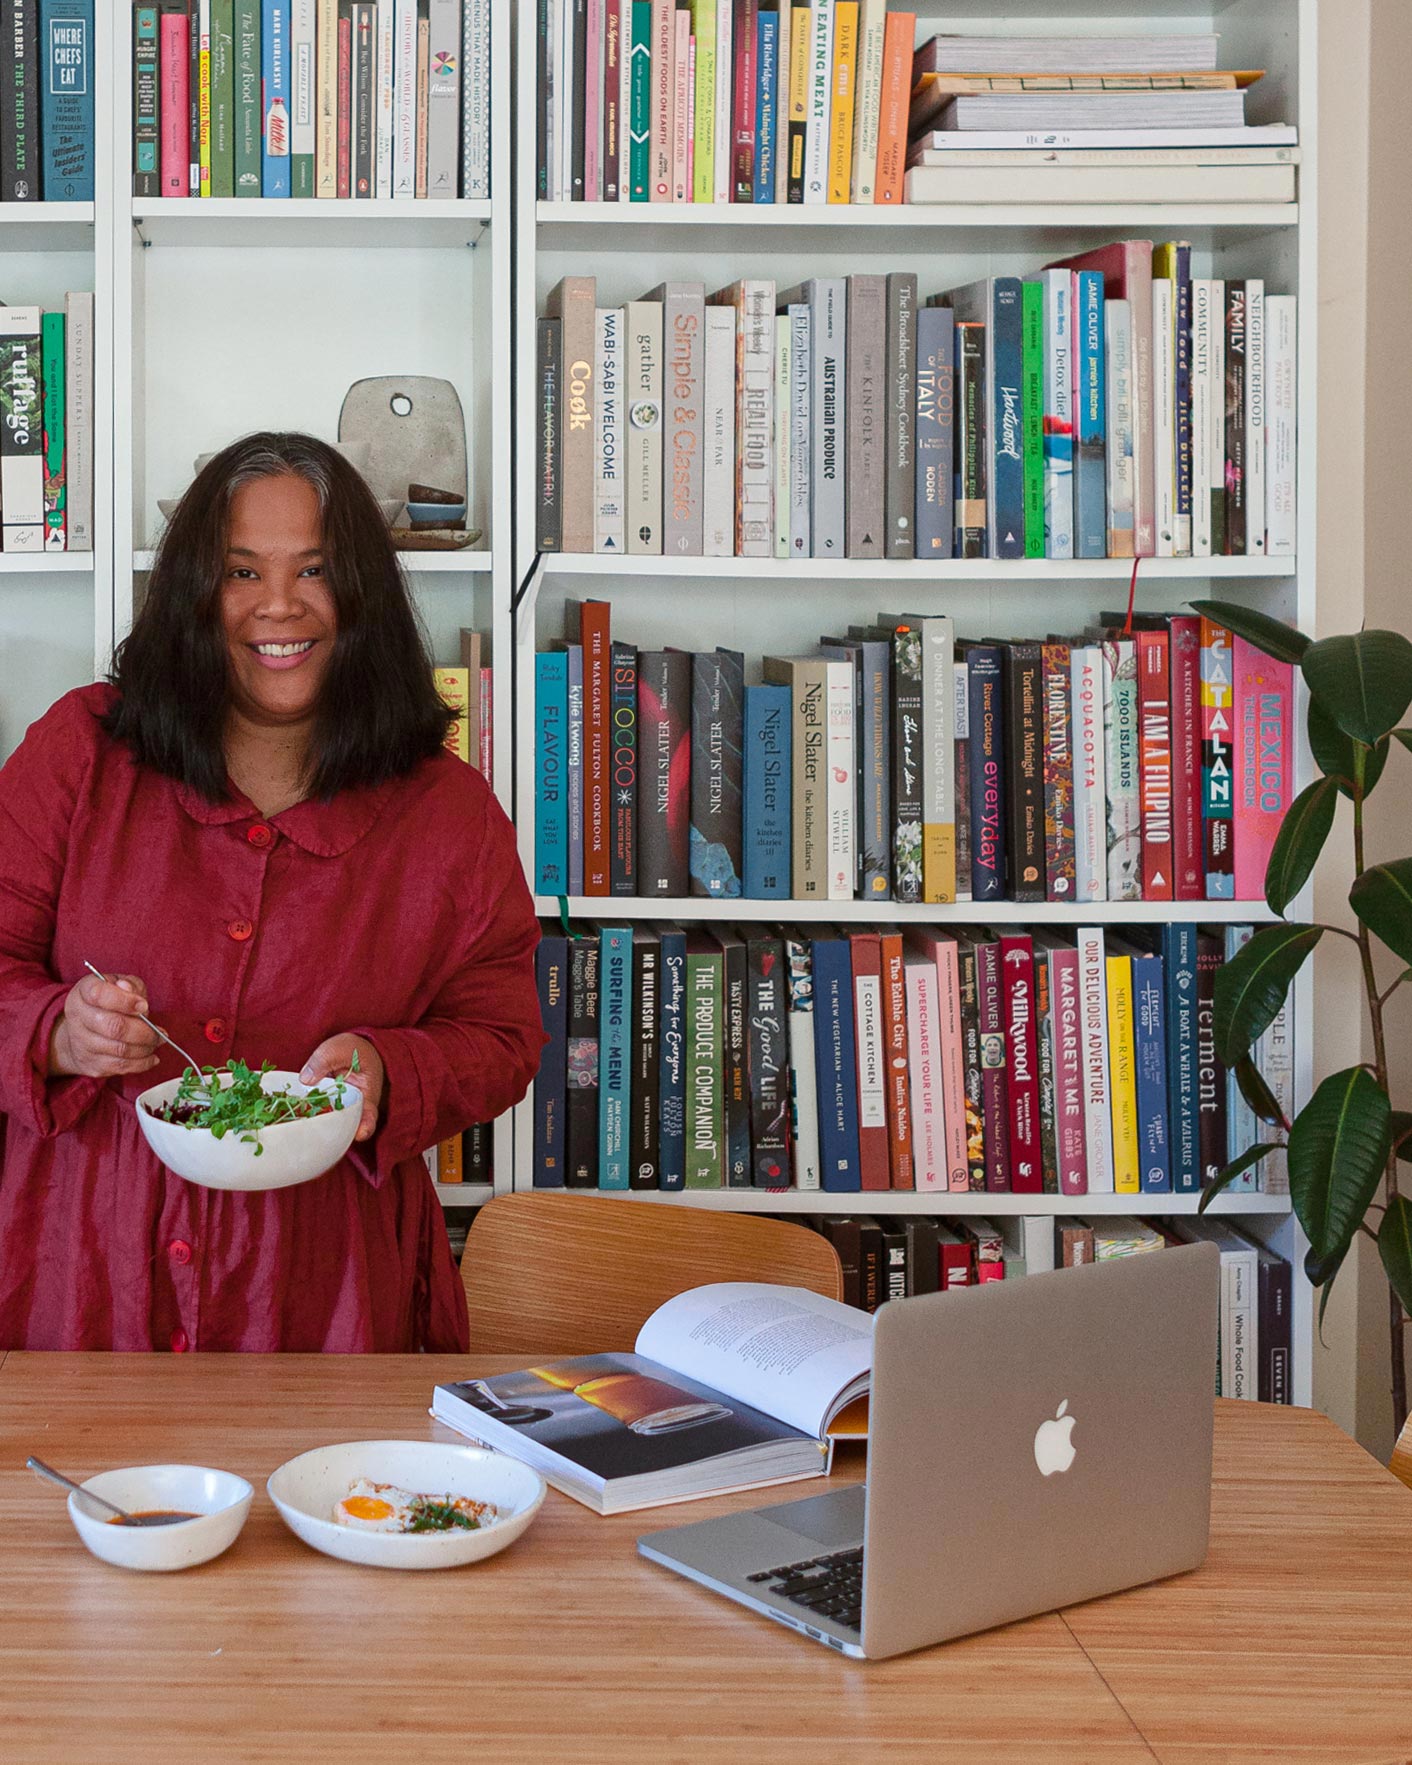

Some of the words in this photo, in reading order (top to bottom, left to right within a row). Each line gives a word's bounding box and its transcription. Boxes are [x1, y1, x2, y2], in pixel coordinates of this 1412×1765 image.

[14, 11, 24, 58] BARBER
[54, 28, 82, 44] WHERE
[242, 13, 252, 29] The
[273, 9, 281, 35] MARK
[764, 24, 773, 41] Ella
[54, 49, 82, 65] CHEFS
[242, 32, 254, 57] Fate
[816, 18, 827, 70] EATING
[15, 63, 24, 86] THE
[61, 68, 76, 84] EAT
[240, 59, 248, 69] of
[273, 38, 281, 90] KURLANSKY
[761, 43, 773, 93] Risbridger
[242, 71, 254, 103] Food
[660, 96, 666, 111] ON
[814, 75, 825, 117] MEAT
[15, 92, 24, 129] THIRD
[760, 103, 773, 143] Midnight
[837, 112, 845, 141] BRUCE
[16, 133, 25, 171] PLATE
[760, 145, 770, 185] Chicken
[835, 144, 844, 178] PASCOE
[900, 285, 911, 309] The
[1087, 279, 1098, 309] JAMIE
[900, 310, 910, 370] Broadsheet
[1087, 312, 1098, 350] OLIVER
[1198, 288, 1207, 376] COMMUNITY
[1229, 290, 1245, 354] FAMILY
[603, 314, 616, 394] WABI-SABI
[637, 335, 655, 391] gather
[670, 314, 698, 399] Simple
[1056, 348, 1066, 387] Detox
[1251, 294, 1262, 427] NEIGHBOURHOOD
[6, 345, 36, 445] ruffage
[896, 372, 910, 411] Sydney
[1056, 391, 1066, 416] diet
[673, 406, 697, 424] &
[998, 386, 1020, 459] Hartwood
[602, 400, 615, 480] WELCOME
[898, 413, 910, 467] Cookbook
[672, 429, 696, 522] Classic
[927, 466, 935, 502] RODEN
[592, 631, 600, 654] THE
[592, 661, 600, 726] MARGARET
[933, 653, 943, 696] DINNER
[1022, 669, 1034, 714] Tortellini
[569, 685, 582, 717] kylie
[800, 682, 822, 726] Nigel
[934, 699, 944, 713] AT
[983, 683, 993, 711] River
[1119, 690, 1129, 726] 7000
[1245, 696, 1255, 721] THE
[758, 708, 781, 756] Nigel
[935, 717, 944, 737] THE
[982, 713, 993, 756] Cottage
[1023, 717, 1032, 727] at
[1048, 674, 1067, 761] FLORENTINE
[1081, 665, 1096, 788] ACQUACOTTA
[1143, 714, 1169, 740] AM
[1209, 639, 1229, 800] CATALAN
[543, 706, 559, 802] FLAVOUR
[569, 721, 582, 766] kwong
[592, 733, 600, 779] FULTON
[658, 720, 670, 773] SLATER
[710, 721, 722, 773] SLATER
[805, 732, 822, 782] Slater
[935, 742, 944, 775] LONG
[1021, 731, 1035, 778] Midnight
[1119, 728, 1130, 788] ISLANDS
[1144, 748, 1168, 758] A
[1260, 694, 1281, 812] MEXICO
[1245, 724, 1255, 807] COOKBOOK
[658, 775, 669, 813] NIGEL
[710, 775, 722, 814] NIGEL
[764, 760, 781, 811] Slater
[805, 790, 814, 802] the
[935, 779, 945, 813] TABLE
[1145, 764, 1171, 843] FILIPINO
[593, 785, 601, 851] COOKBOOK
[805, 805, 815, 838] kitchen
[976, 762, 999, 870] everyday
[1026, 806, 1034, 828] Emiko
[805, 839, 814, 870] diaries
[1026, 829, 1034, 855] Davies
[572, 950, 584, 991] Maggie's
[584, 950, 598, 989] Maggie
[643, 954, 654, 969] MR
[890, 956, 900, 981] The
[985, 948, 996, 983] JAMIE
[1085, 941, 1098, 963] OUR
[548, 965, 561, 1006] trullo
[665, 956, 684, 1016] Something
[695, 965, 714, 991] THE
[758, 980, 774, 1011] THE
[573, 994, 583, 1018] Table
[586, 992, 598, 1018] Beer
[642, 972, 654, 1039] WILKINSON'S
[865, 993, 873, 1037] COTTAGE
[891, 982, 902, 1024] Edible
[917, 978, 929, 1056] SUPERCHARGE
[986, 986, 998, 1029] OLIVER
[1086, 967, 1100, 1029] DELICIOUS
[1116, 987, 1125, 1021] MOLLY
[671, 1017, 680, 1030] for
[695, 998, 714, 1059] PRODUCE
[892, 1024, 904, 1049] City
[1010, 980, 1032, 1082] Milkwood
[1060, 967, 1078, 1072] MARGARET
[665, 1031, 682, 1084] Everyone
[752, 1016, 780, 1072] Good
[833, 1020, 841, 1071] VEGETARIAN
[866, 1041, 876, 1084] KITCHEN
[921, 1058, 931, 1089] YOUR
[1089, 1033, 1104, 1104] ADVENTURE
[1118, 1046, 1129, 1084] RANGE
[694, 1066, 714, 1150] COMPANION
[761, 1077, 777, 1111] LIFE
[835, 1083, 843, 1109] ALICE
[896, 1076, 905, 1104] Indira
[923, 1093, 932, 1114] LIFE
[1065, 1088, 1079, 1115] ME
[898, 1107, 907, 1141] Naidoo
[1065, 1127, 1074, 1159] GIBBS
[1074, 1130, 1082, 1156] KATE
